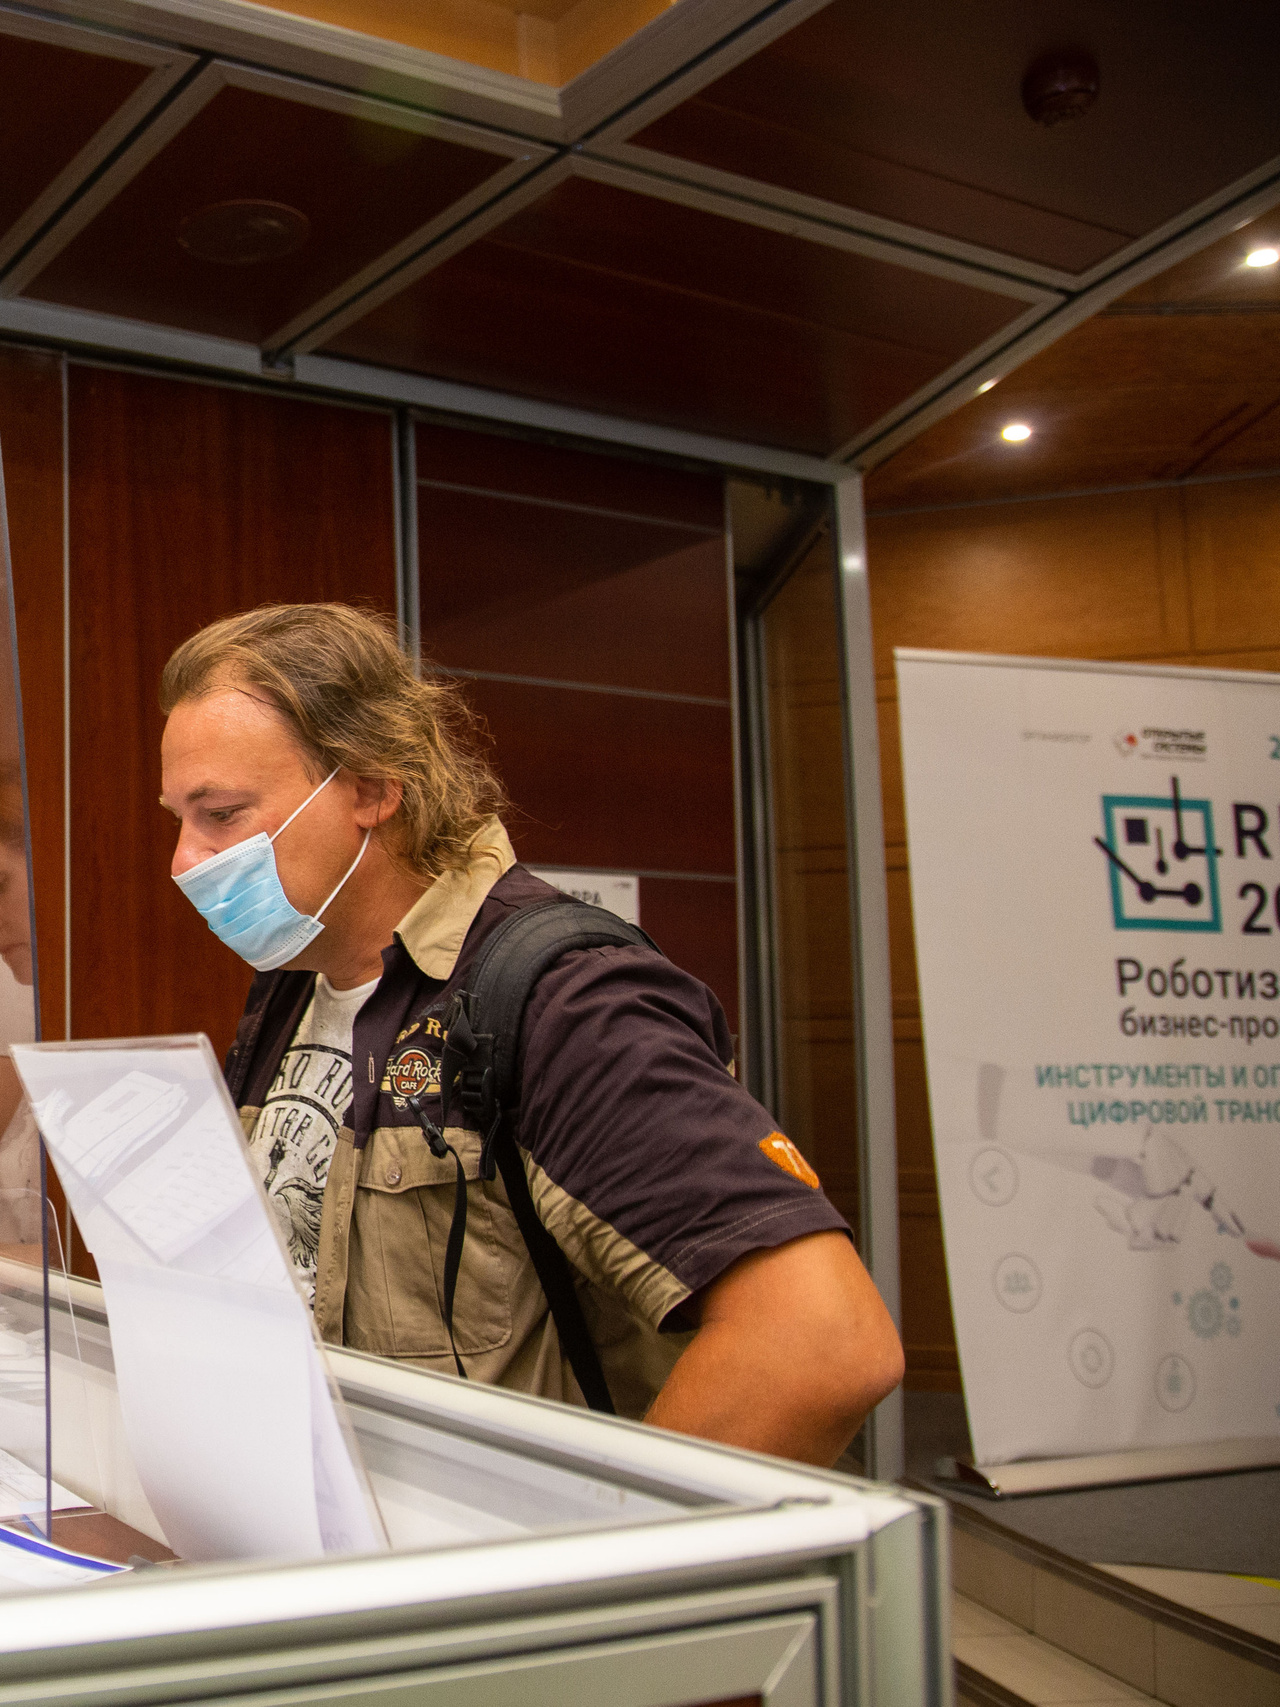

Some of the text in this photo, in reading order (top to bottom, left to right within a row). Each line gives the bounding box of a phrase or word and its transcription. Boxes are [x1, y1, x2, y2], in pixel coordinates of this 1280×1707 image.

[1232, 802, 1280, 859] R
[1237, 882, 1280, 936] 2
[1115, 956, 1280, 1000] Роботиз
[1120, 1005, 1280, 1047] бизнес-про
[385, 1060, 442, 1082] Hard Rock
[400, 1081, 418, 1090] CAFE
[1034, 1062, 1226, 1089] ИНСТРУМЕНТЫ
[1231, 1063, 1249, 1088] И
[1067, 1093, 1209, 1129] ЦИФРОВОЙ
